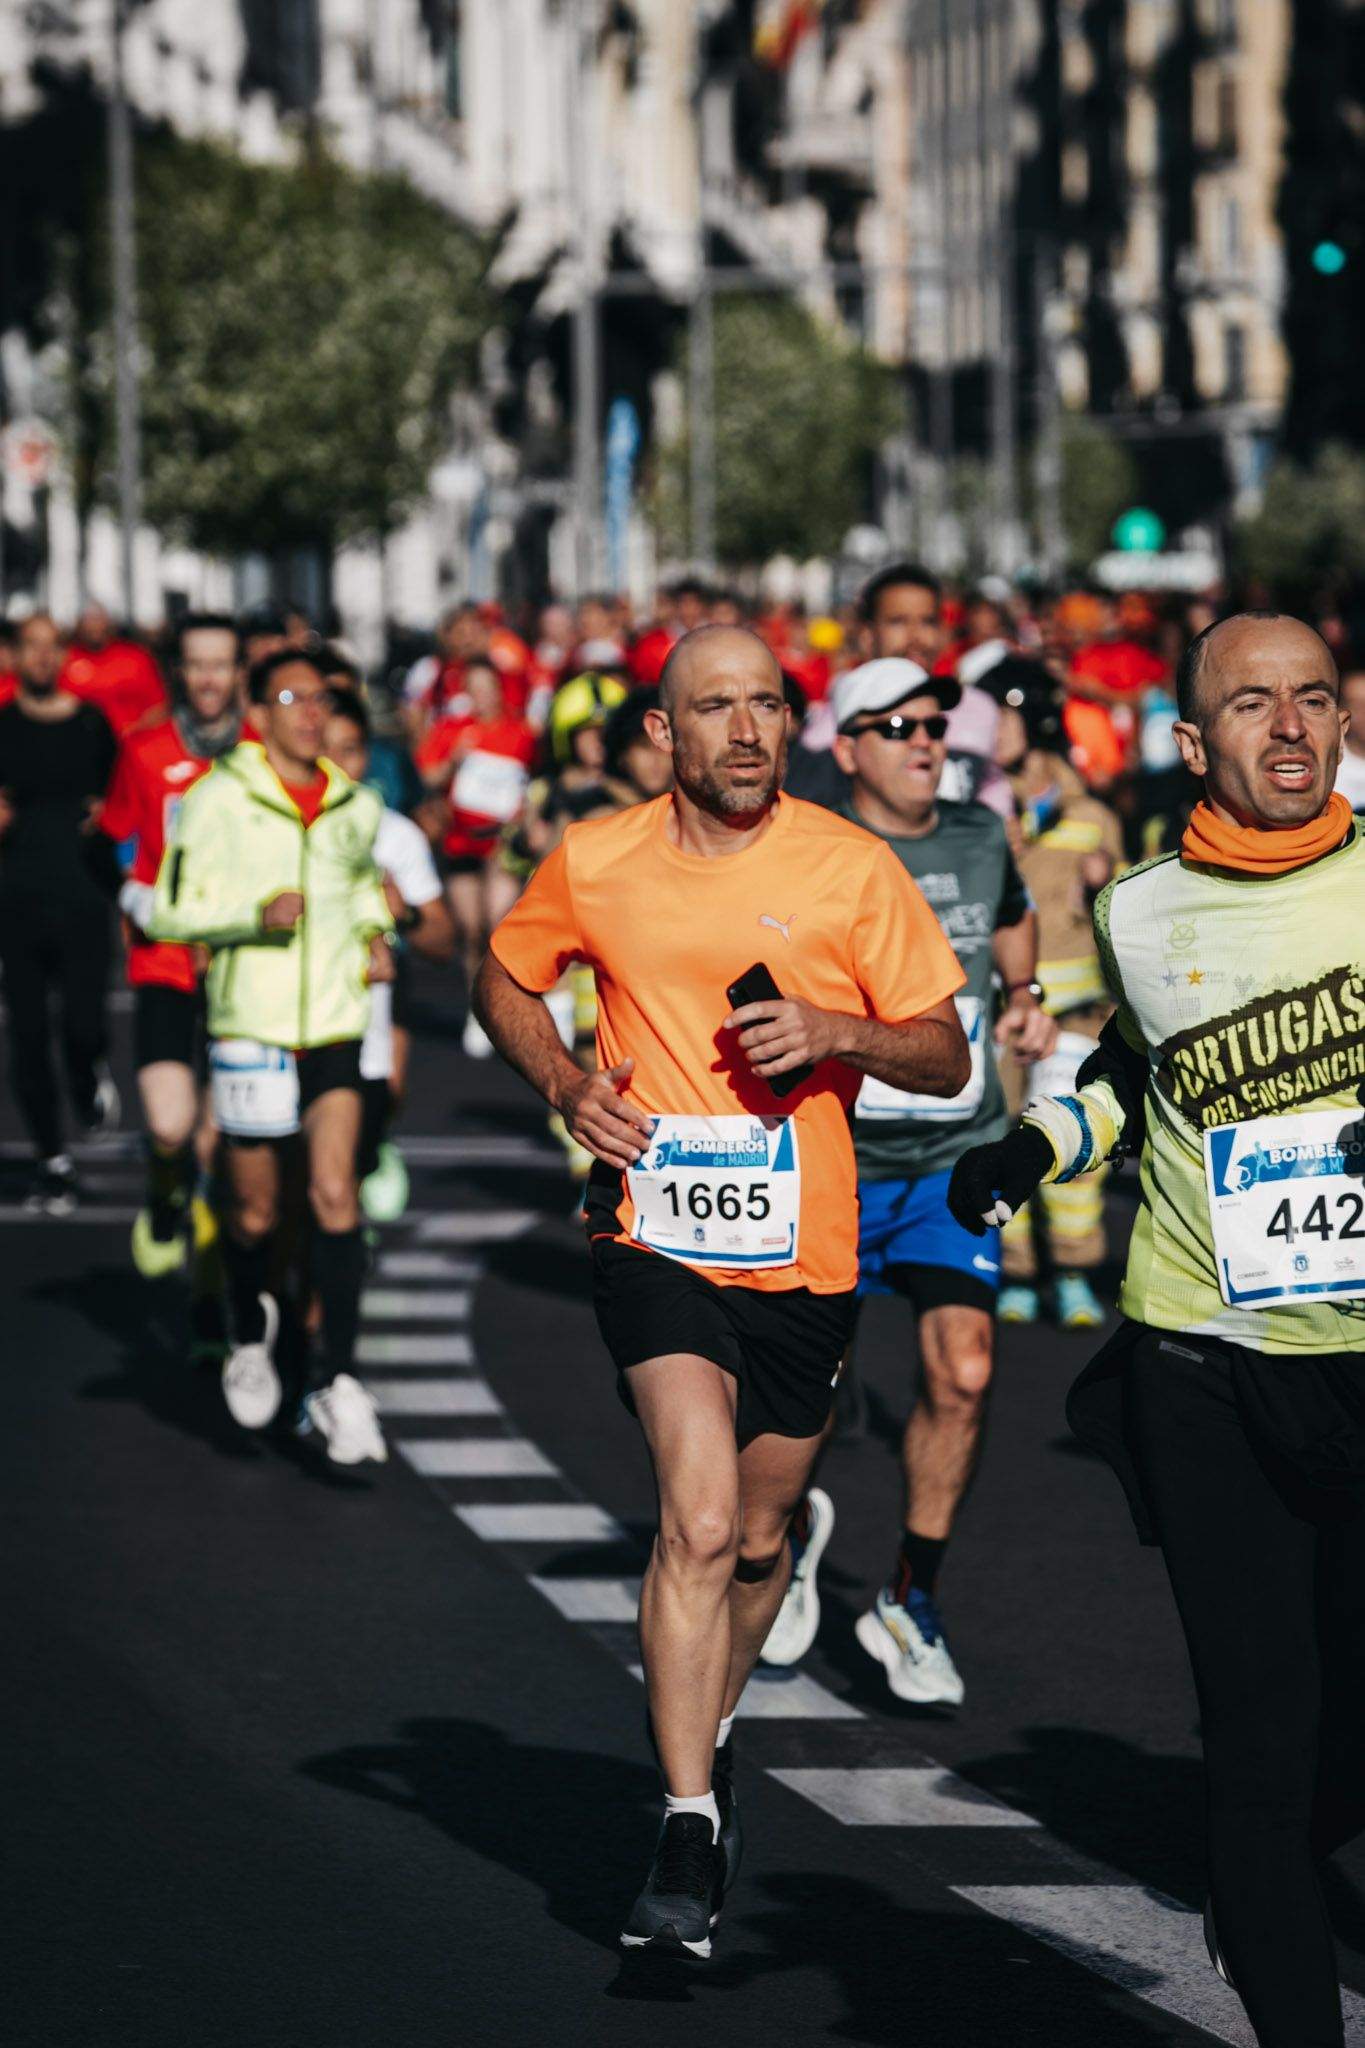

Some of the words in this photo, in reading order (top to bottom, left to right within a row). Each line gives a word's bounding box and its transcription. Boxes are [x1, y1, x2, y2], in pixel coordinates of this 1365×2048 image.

[1202, 1094, 1245, 1128] DEL
[1241, 1043, 1365, 1112] ENSANCH
[680, 1140, 767, 1154] BOMBEROS
[713, 1153, 726, 1166] de
[728, 1153, 767, 1166] MADRID
[1269, 1138, 1365, 1164] BOMBERO
[662, 1181, 771, 1221] 1665
[1266, 1192, 1365, 1244] 442
